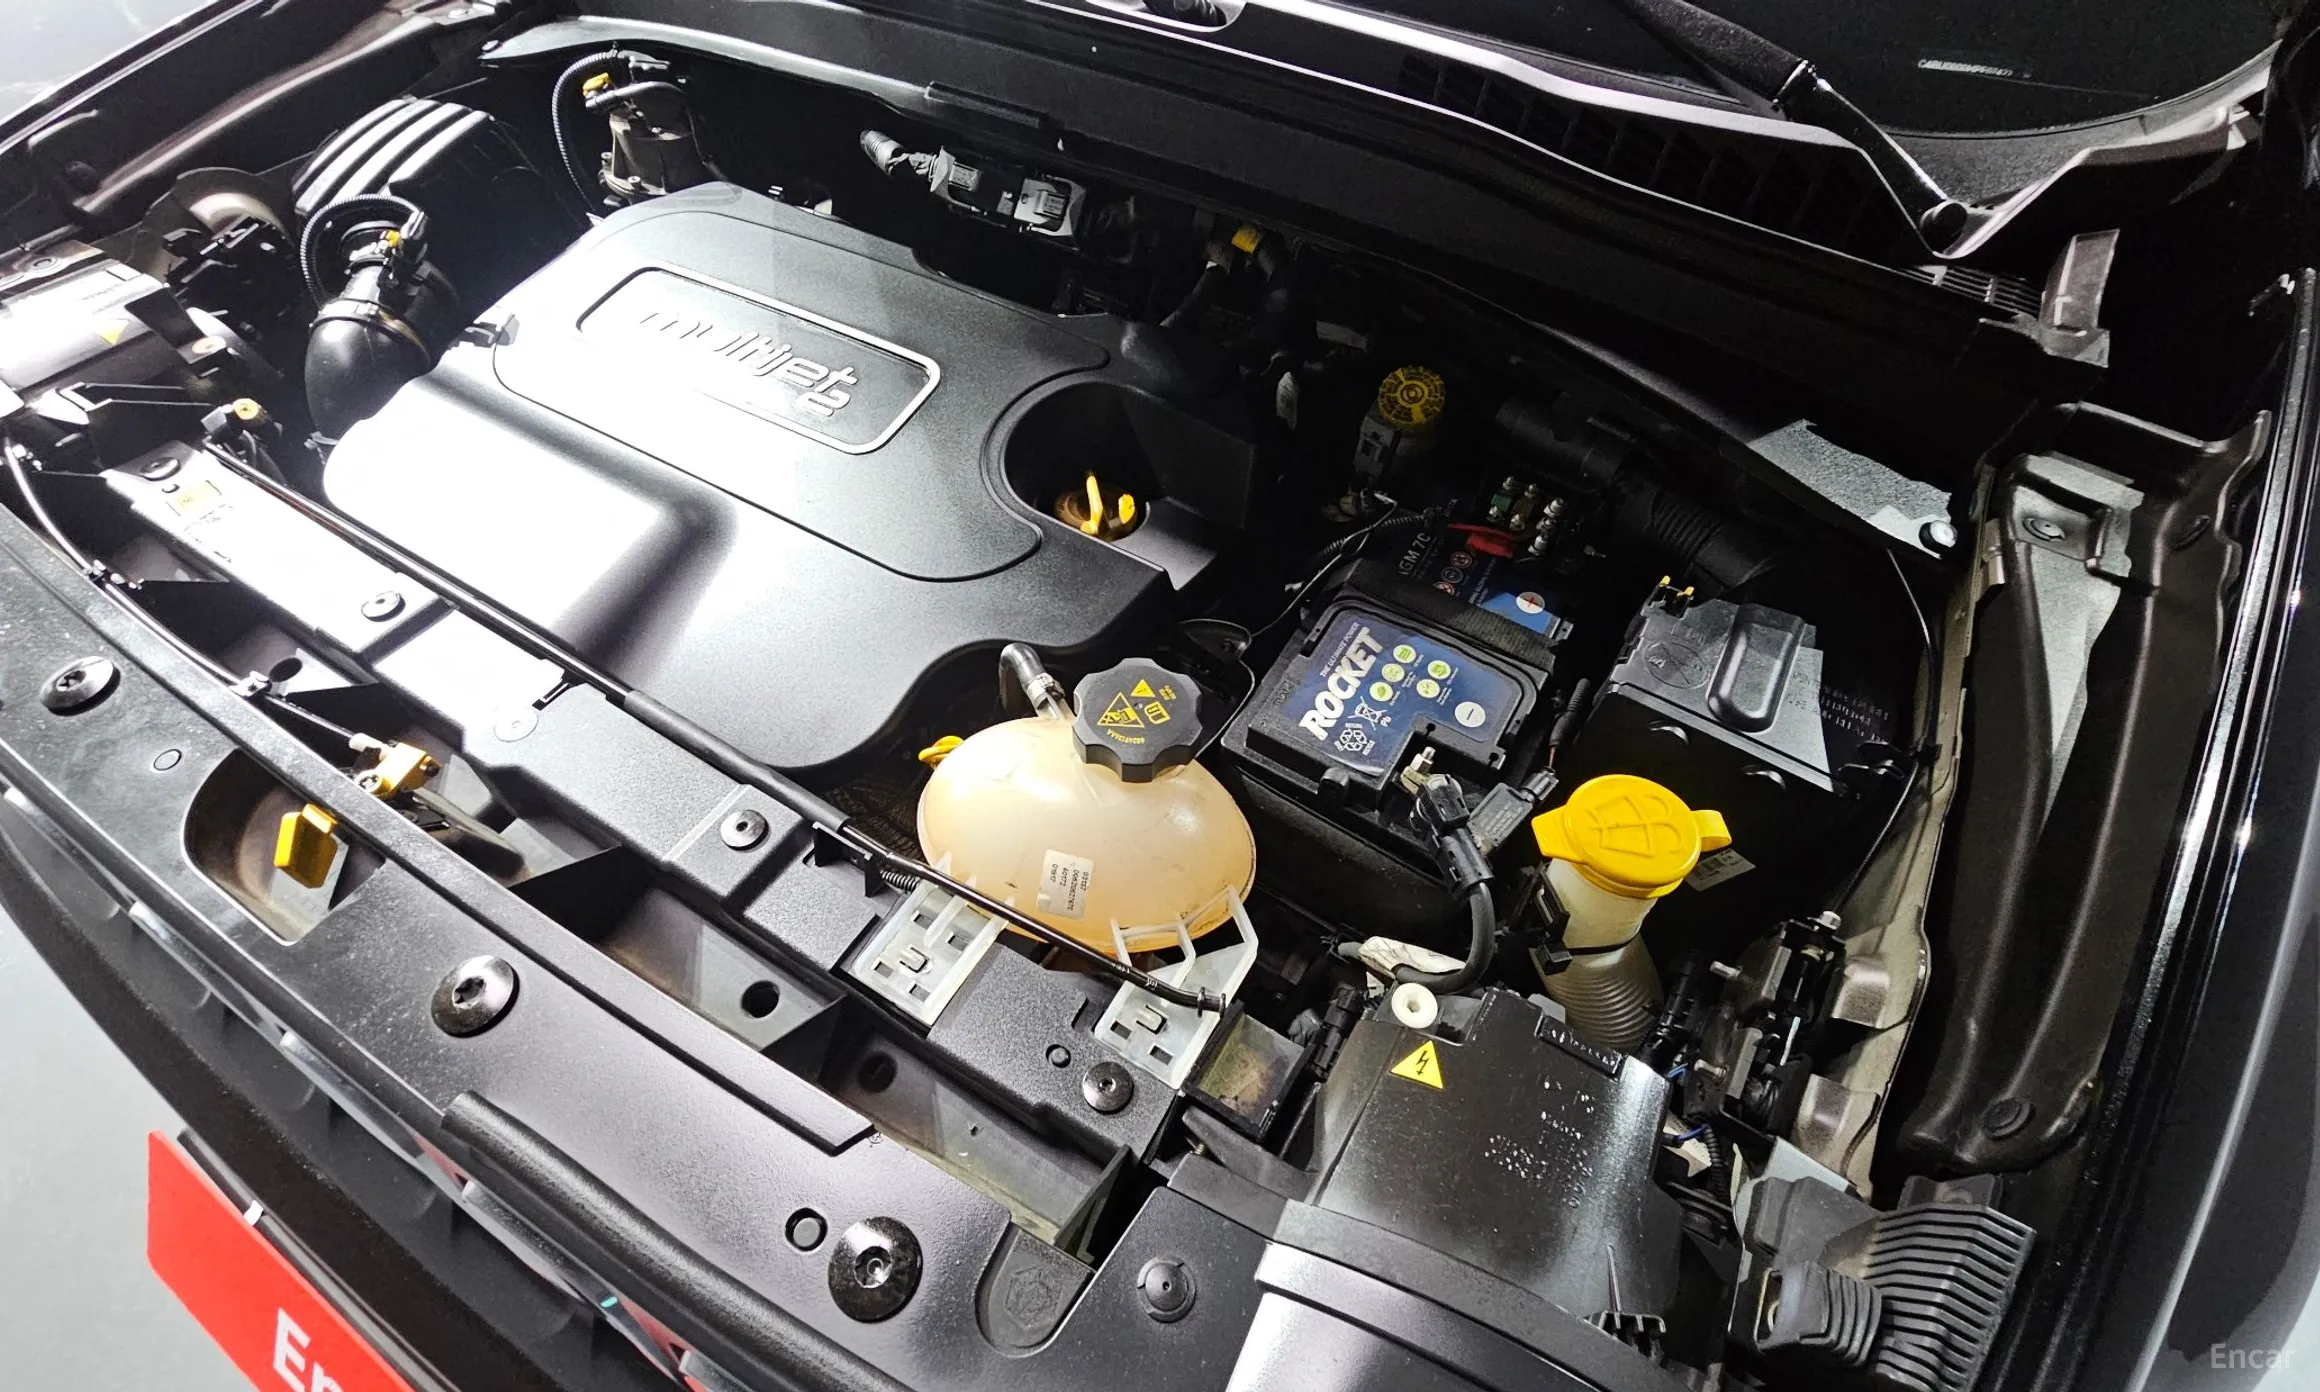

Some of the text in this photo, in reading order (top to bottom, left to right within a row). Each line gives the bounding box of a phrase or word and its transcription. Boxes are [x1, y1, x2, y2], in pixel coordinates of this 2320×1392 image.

[1298, 626, 1384, 741] ROCKET
[1319, 621, 1360, 678] THE ULTIMATE POWER
